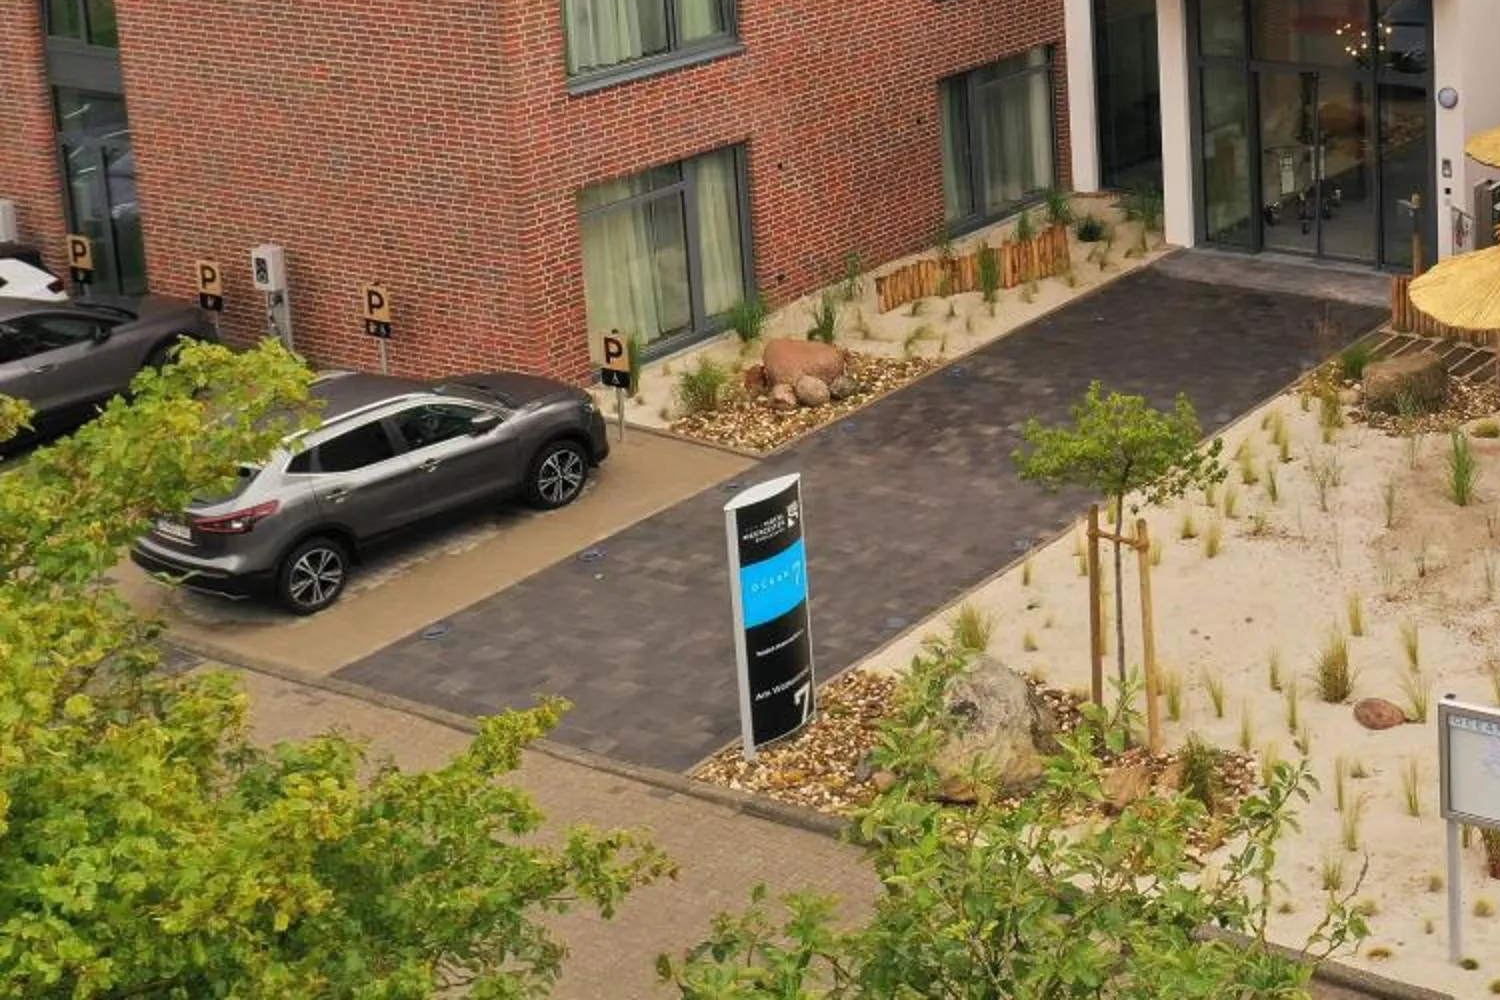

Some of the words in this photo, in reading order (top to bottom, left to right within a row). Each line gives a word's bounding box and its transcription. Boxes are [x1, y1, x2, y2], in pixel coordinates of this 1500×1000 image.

[71, 239, 87, 263] P
[201, 264, 217, 289] P
[367, 289, 384, 315] P
[604, 336, 622, 364] P
[793, 680, 811, 724] 7
